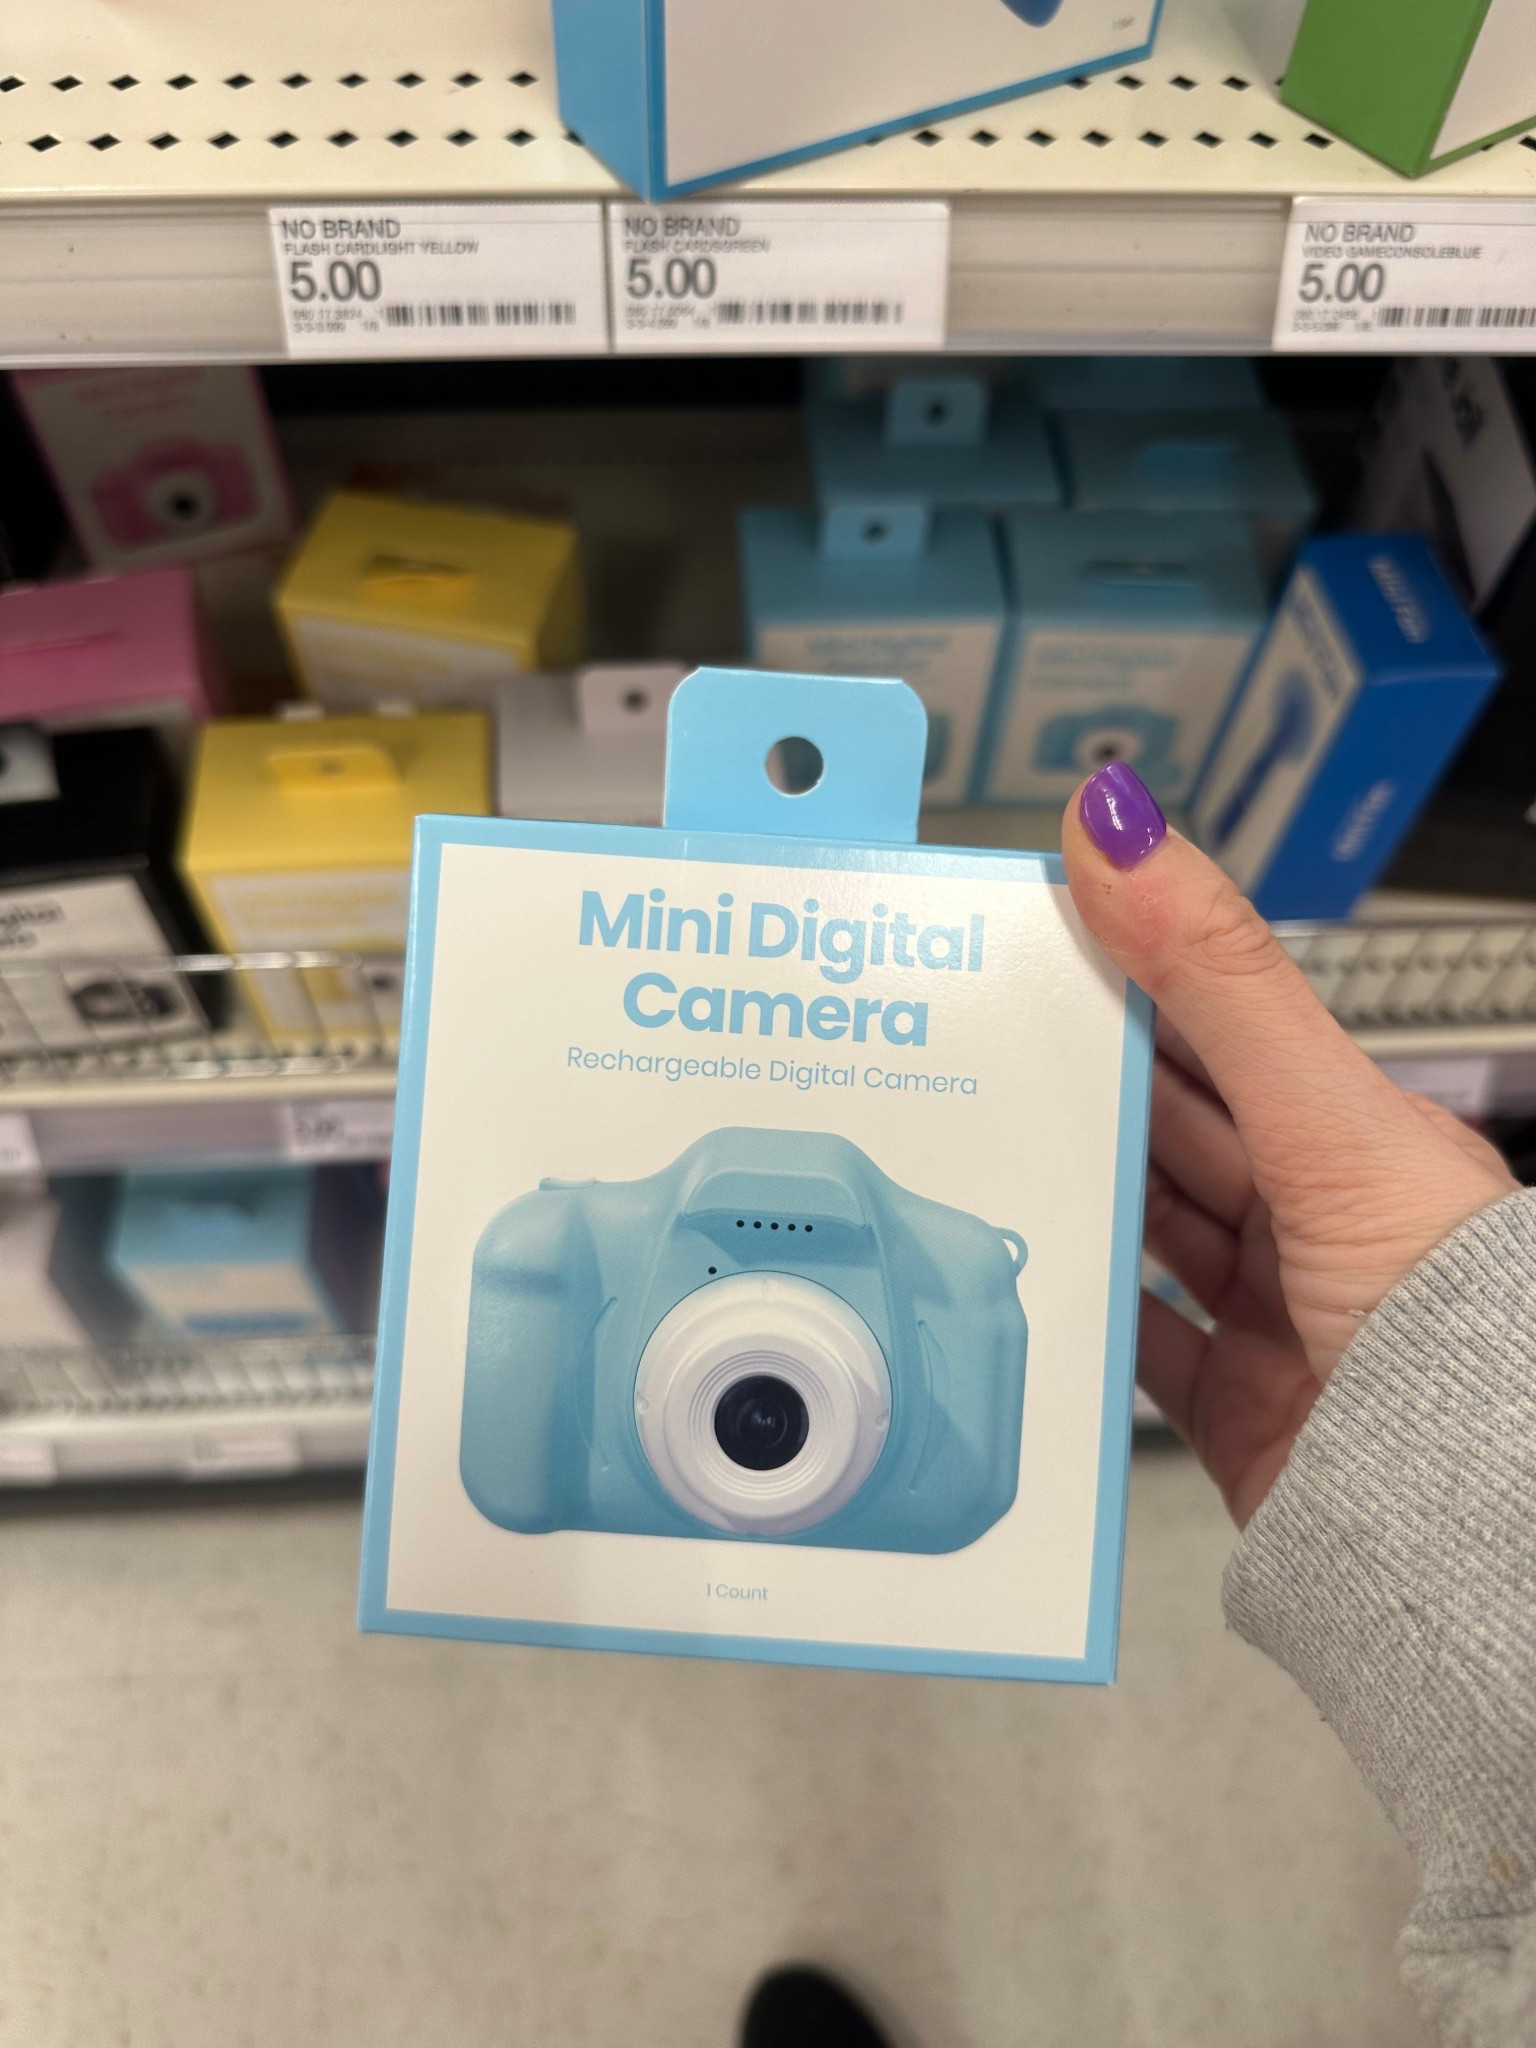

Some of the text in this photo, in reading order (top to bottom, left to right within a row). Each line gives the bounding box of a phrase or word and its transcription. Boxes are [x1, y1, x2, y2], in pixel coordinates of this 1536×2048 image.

[282, 218, 401, 239] NO BRAND
[624, 216, 741, 237] NO BRAND
[1305, 224, 1416, 243] NO BRAND
[284, 243, 331, 255] FLASH
[420, 242, 479, 255] YELLOW
[1302, 246, 1342, 258] VIDEO
[289, 260, 382, 302] 5.00
[626, 257, 717, 299] 5.00
[1298, 263, 1384, 303] 5.00
[579, 888, 985, 985] Mini Digital
[623, 972, 929, 1047] Camera
[567, 1046, 978, 1095] Rechargeable Digital Camera
[716, 1583, 768, 1600] Count
